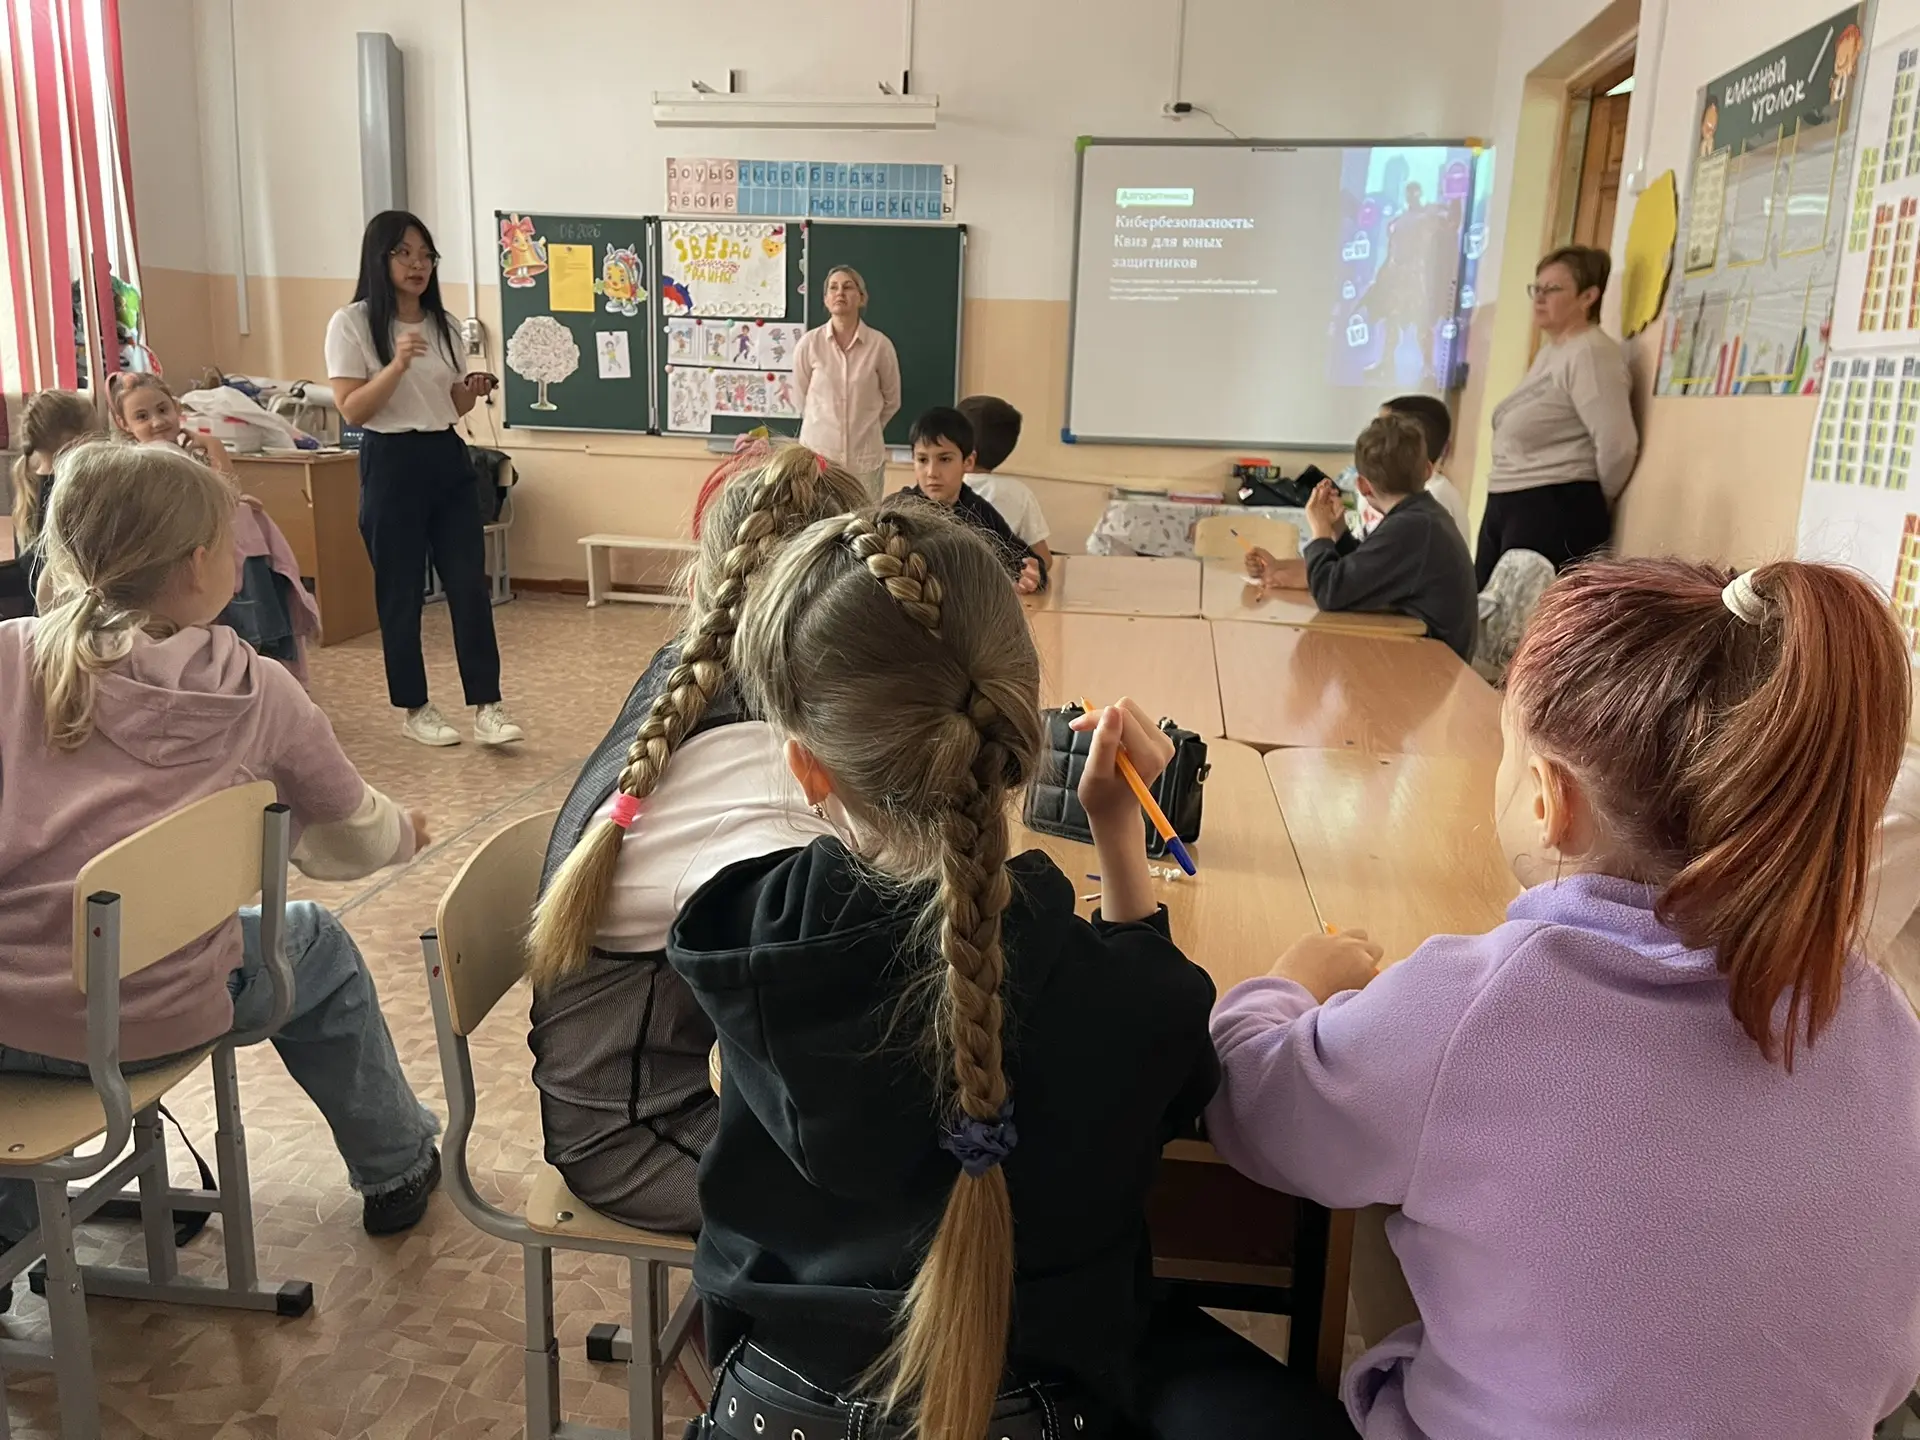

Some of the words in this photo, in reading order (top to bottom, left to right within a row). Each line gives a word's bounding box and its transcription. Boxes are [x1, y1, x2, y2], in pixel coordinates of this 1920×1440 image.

[1724, 55, 1787, 108] КЛАССНЫЙ
[1751, 79, 1806, 124] УГОЛОК
[1115, 215, 1254, 231] Кибербезопасность:
[1114, 234, 1148, 248] Квиз
[1151, 237, 1178, 249] для
[1182, 237, 1224, 249] юных
[1111, 258, 1198, 269] защитников
